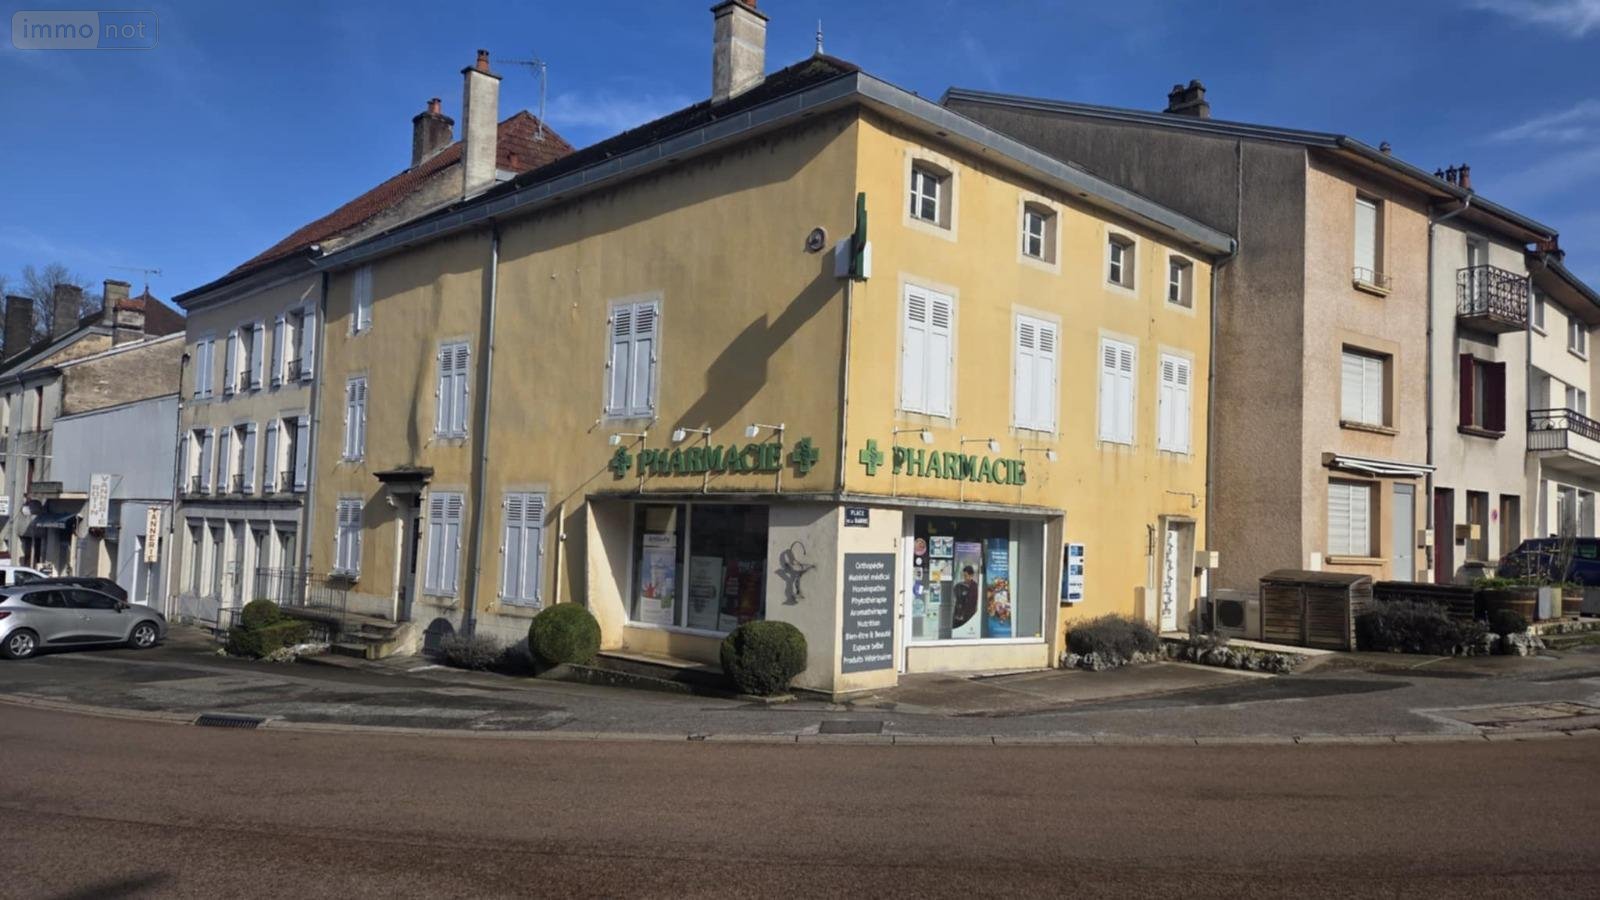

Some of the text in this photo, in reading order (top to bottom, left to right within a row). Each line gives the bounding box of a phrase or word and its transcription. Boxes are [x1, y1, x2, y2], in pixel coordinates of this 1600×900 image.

[637, 443, 783, 476] PHARMACIE
[892, 446, 1027, 486] PHARMACIE
[850, 509, 865, 517] PLACE
[853, 643, 870, 652] Espace
